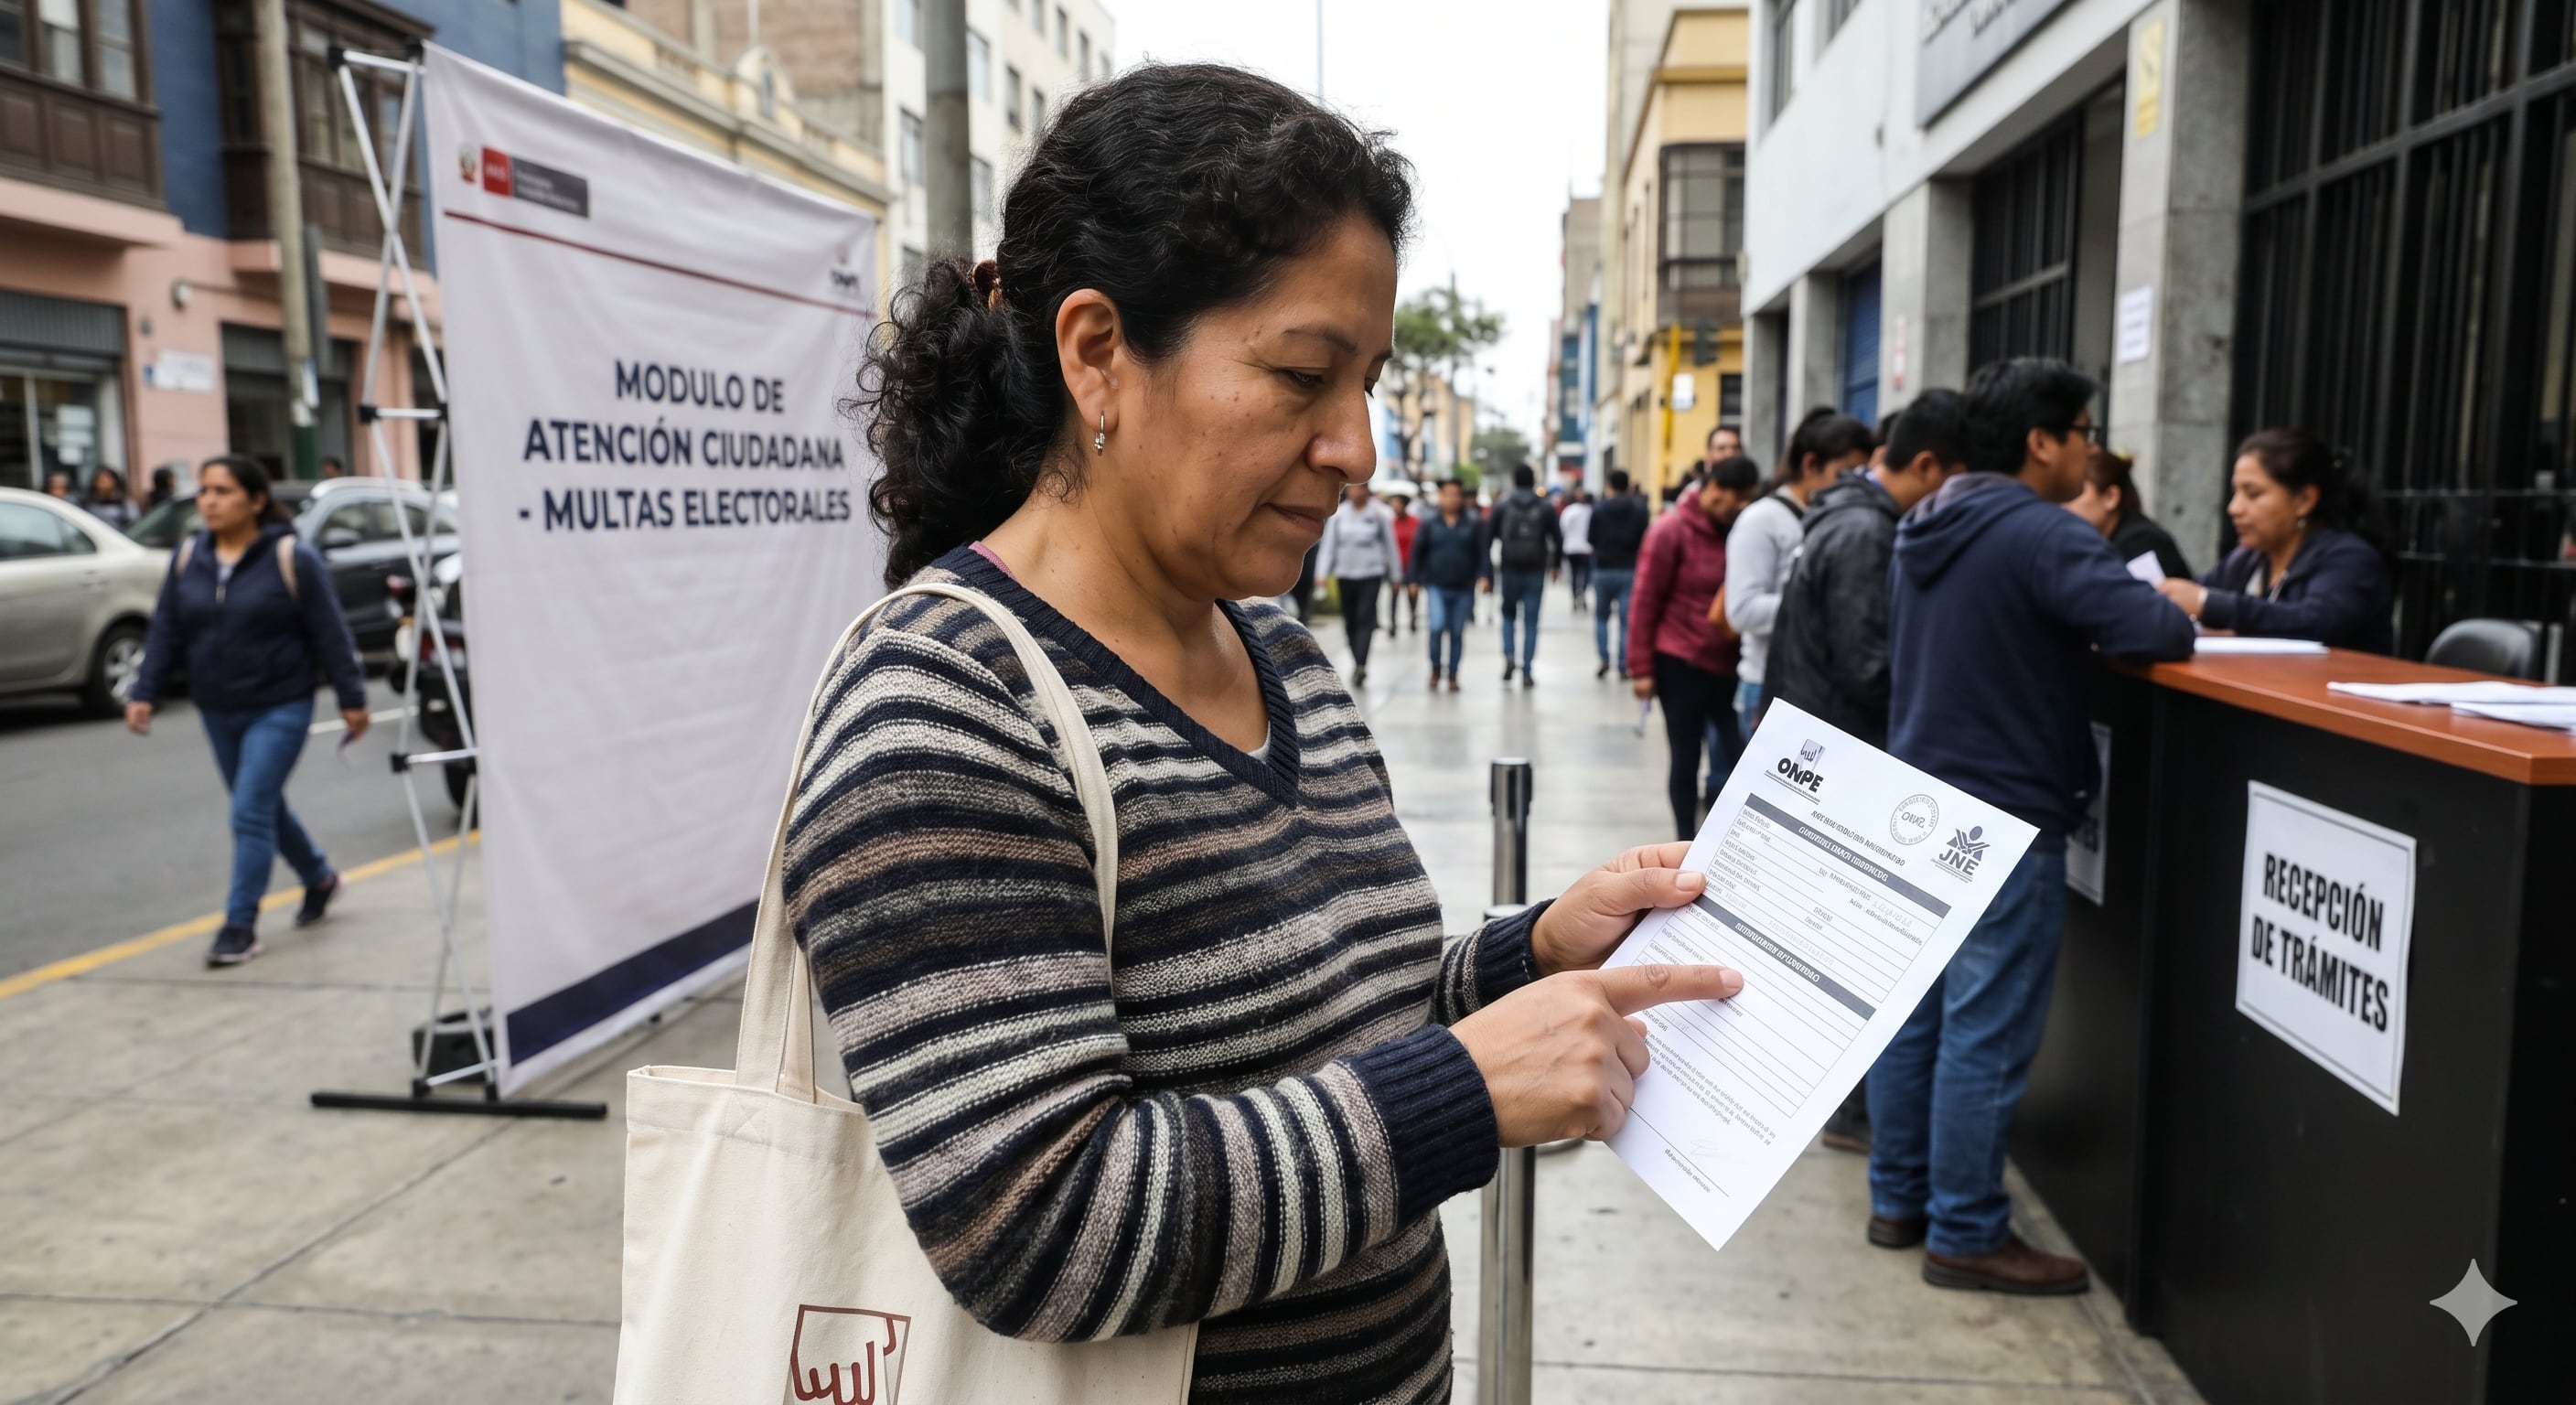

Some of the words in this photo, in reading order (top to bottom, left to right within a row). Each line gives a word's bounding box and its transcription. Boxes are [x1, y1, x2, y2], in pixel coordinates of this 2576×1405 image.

[616, 360, 745, 410] MODULO
[753, 378, 784, 413] DE
[523, 417, 692, 466] ATENCIÓN
[702, 430, 844, 468] CIUDADANA
[543, 489, 674, 531] MULTAS
[683, 489, 852, 527] ELECTORALES
[1777, 757, 1824, 793] ONPE
[1938, 849, 1980, 876] JNE
[2263, 853, 2384, 952] RECEPCIÓN
[2251, 915, 2274, 968] DE
[2280, 928, 2388, 1033] TRÁMITES
